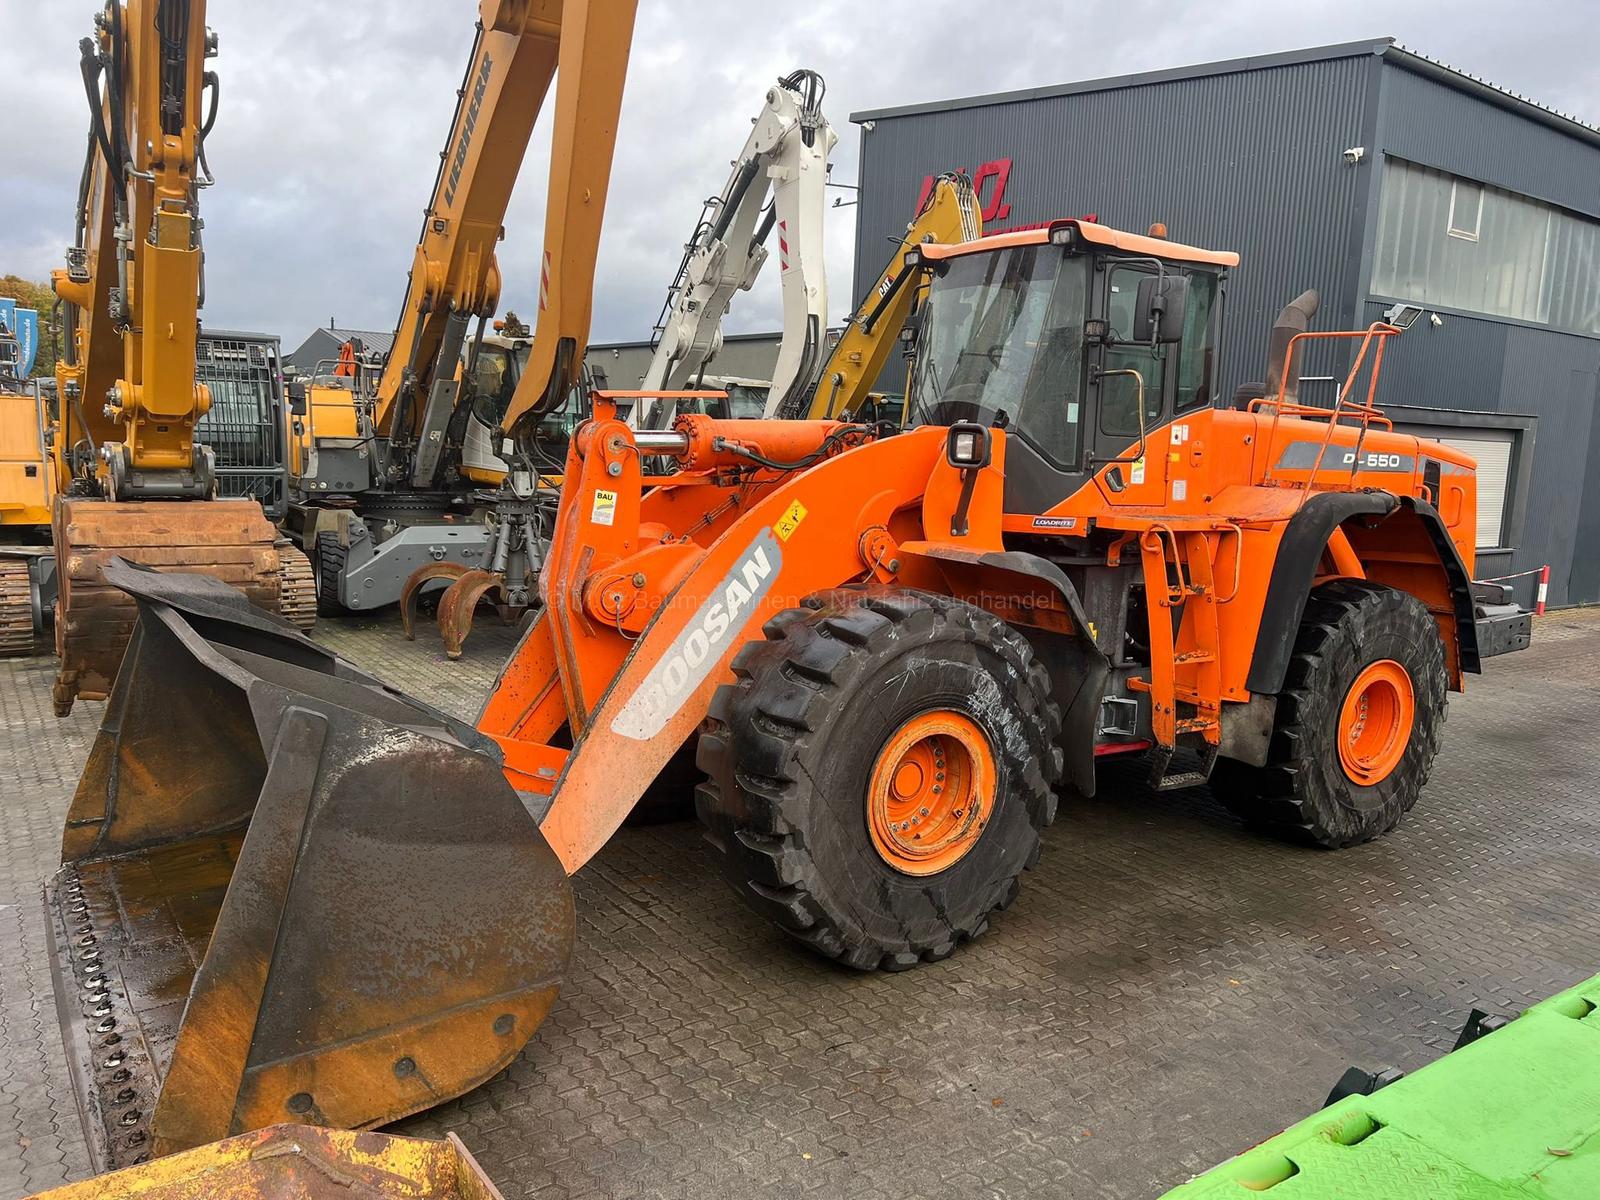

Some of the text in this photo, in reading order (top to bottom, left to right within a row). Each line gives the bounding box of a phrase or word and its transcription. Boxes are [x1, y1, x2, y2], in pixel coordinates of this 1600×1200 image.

[444, 50, 493, 209] LIEBHERR
[879, 276, 892, 299] CAT
[1367, 454, 1400, 467] 550
[597, 492, 613, 501] BAU
